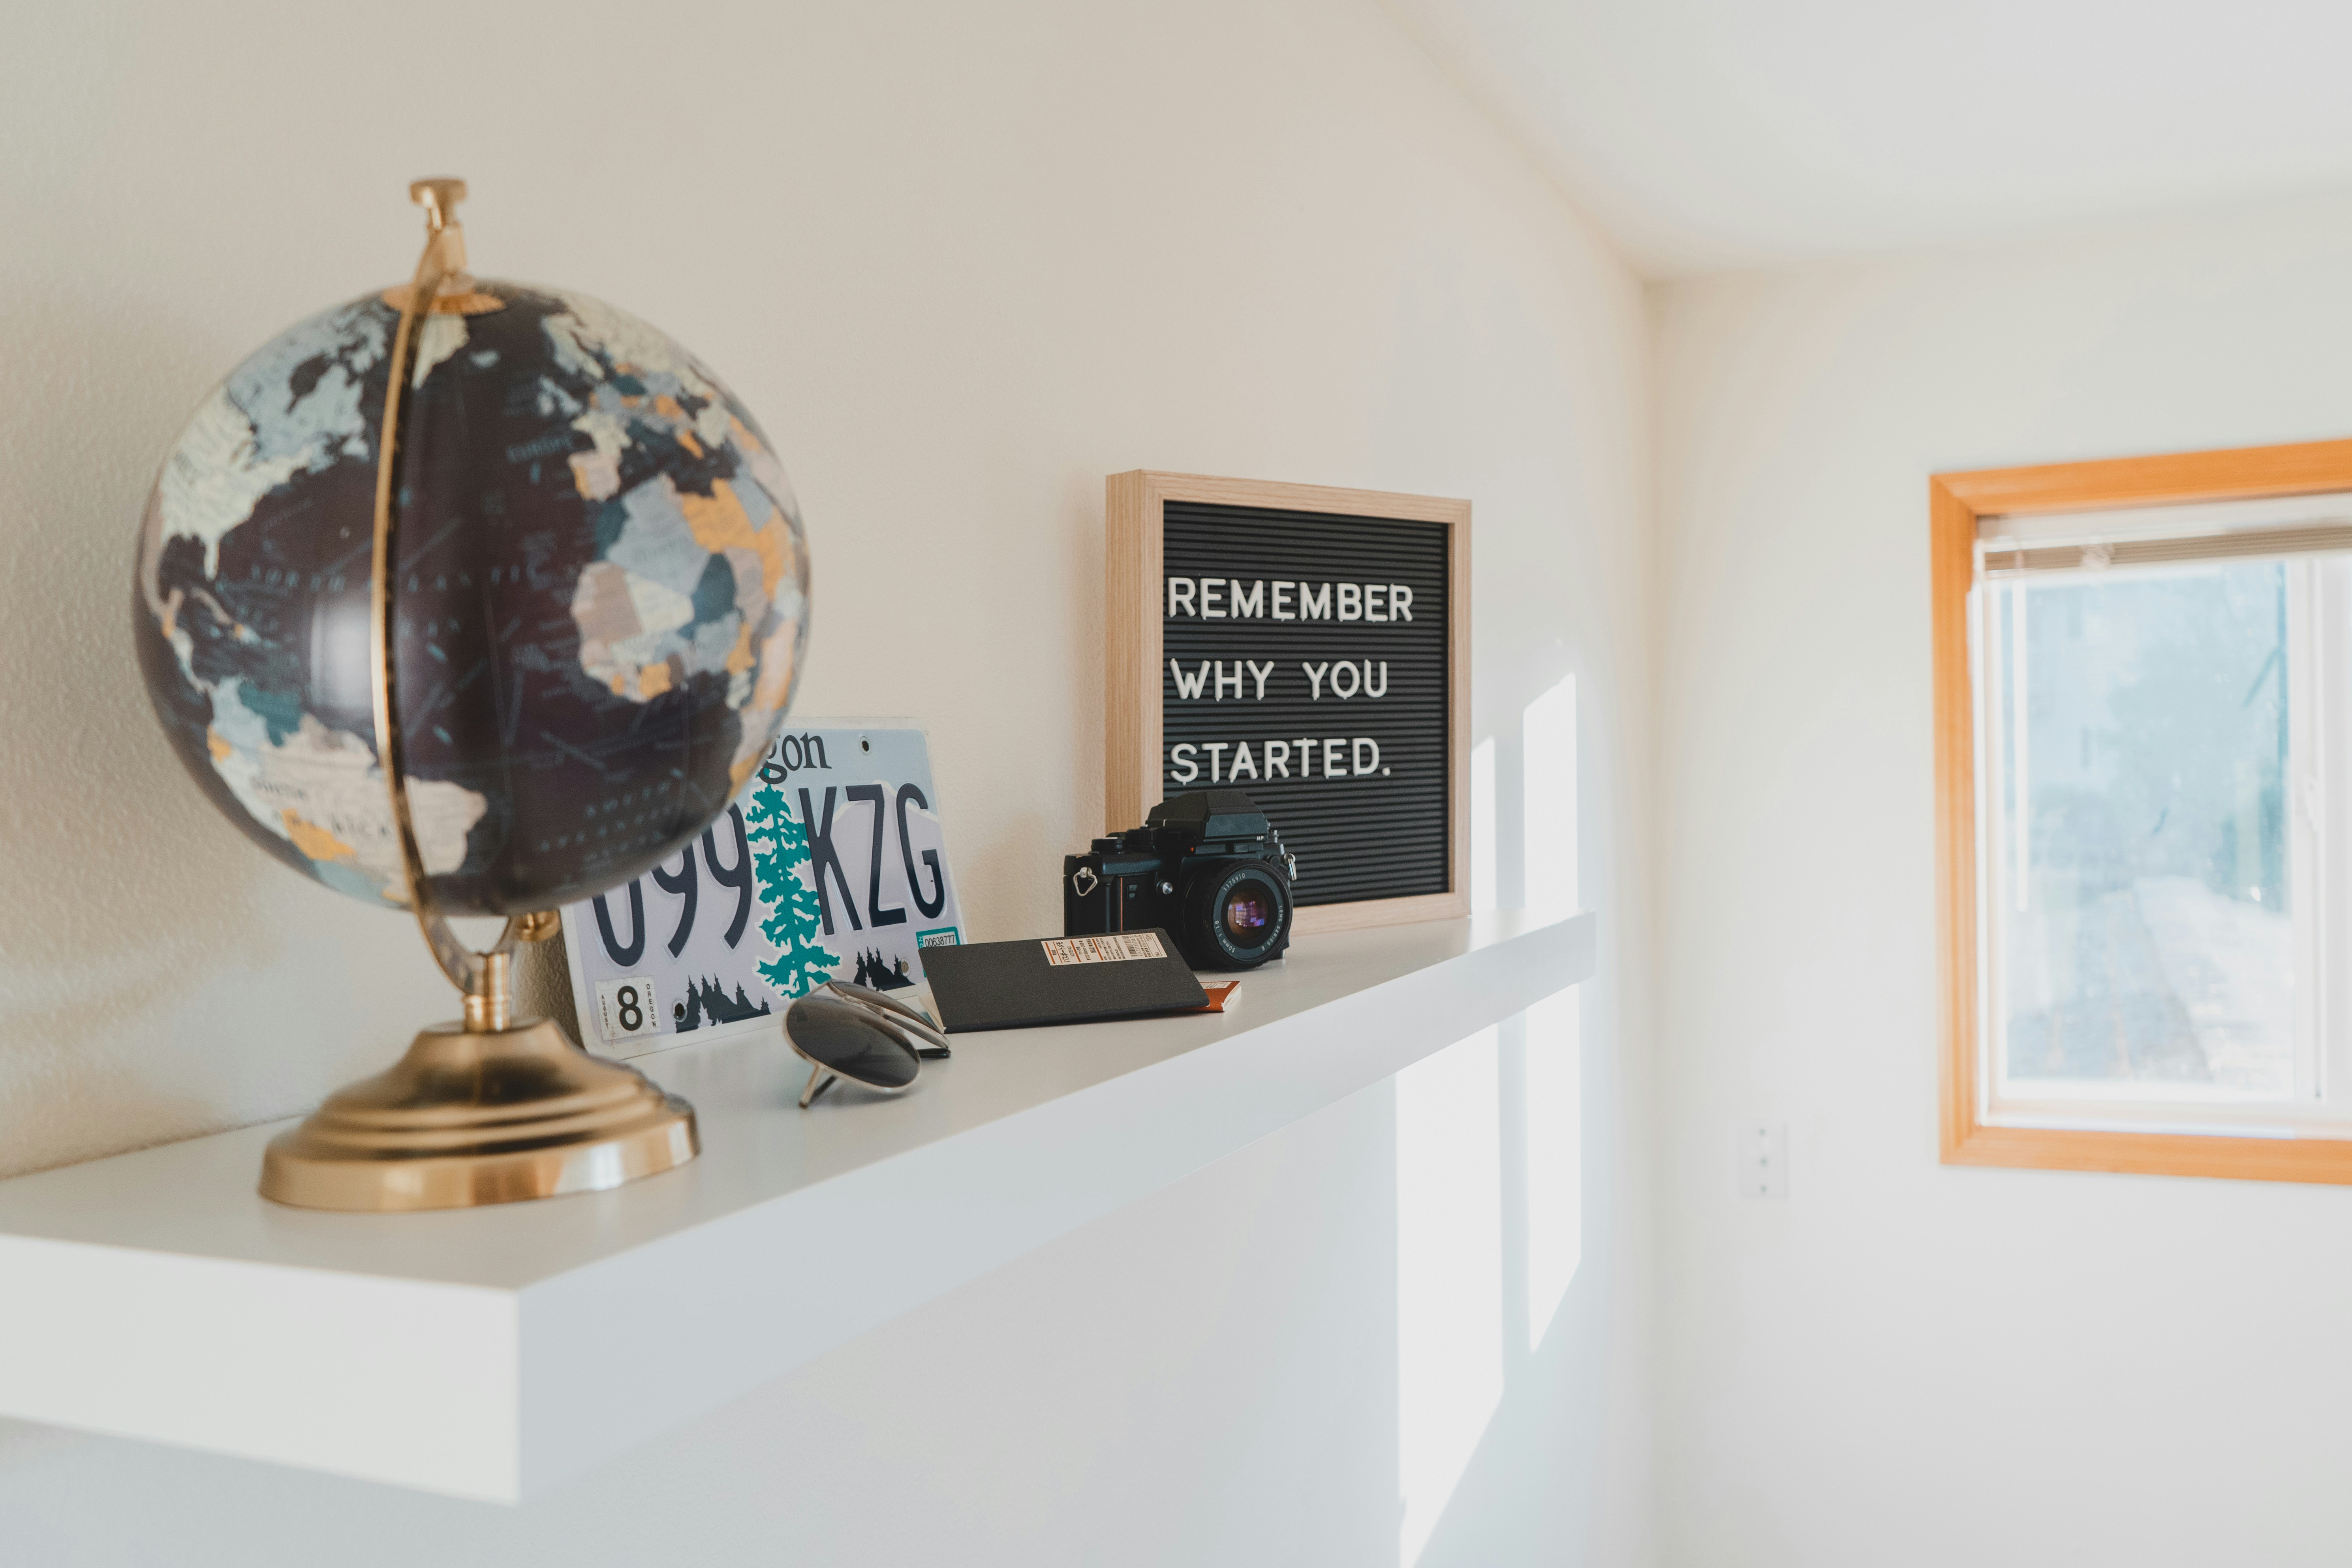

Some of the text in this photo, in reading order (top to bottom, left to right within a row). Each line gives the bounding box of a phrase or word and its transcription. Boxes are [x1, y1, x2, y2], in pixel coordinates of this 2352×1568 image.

[1168, 577, 1413, 623] REMEMBER
[1169, 658, 1388, 702] WHY YOU
[759, 732, 832, 784] gon
[1170, 737, 1391, 785] STARTED.
[798, 783, 945, 936] KZG
[1223, 873, 1246, 891] 1175910
[925, 935, 955, 947] 00638777
[1223, 939, 1235, 953] 50mm
[1266, 925, 1281, 946] SERIES
[617, 985, 643, 1031] 8
[646, 984, 656, 1027] OREGON
